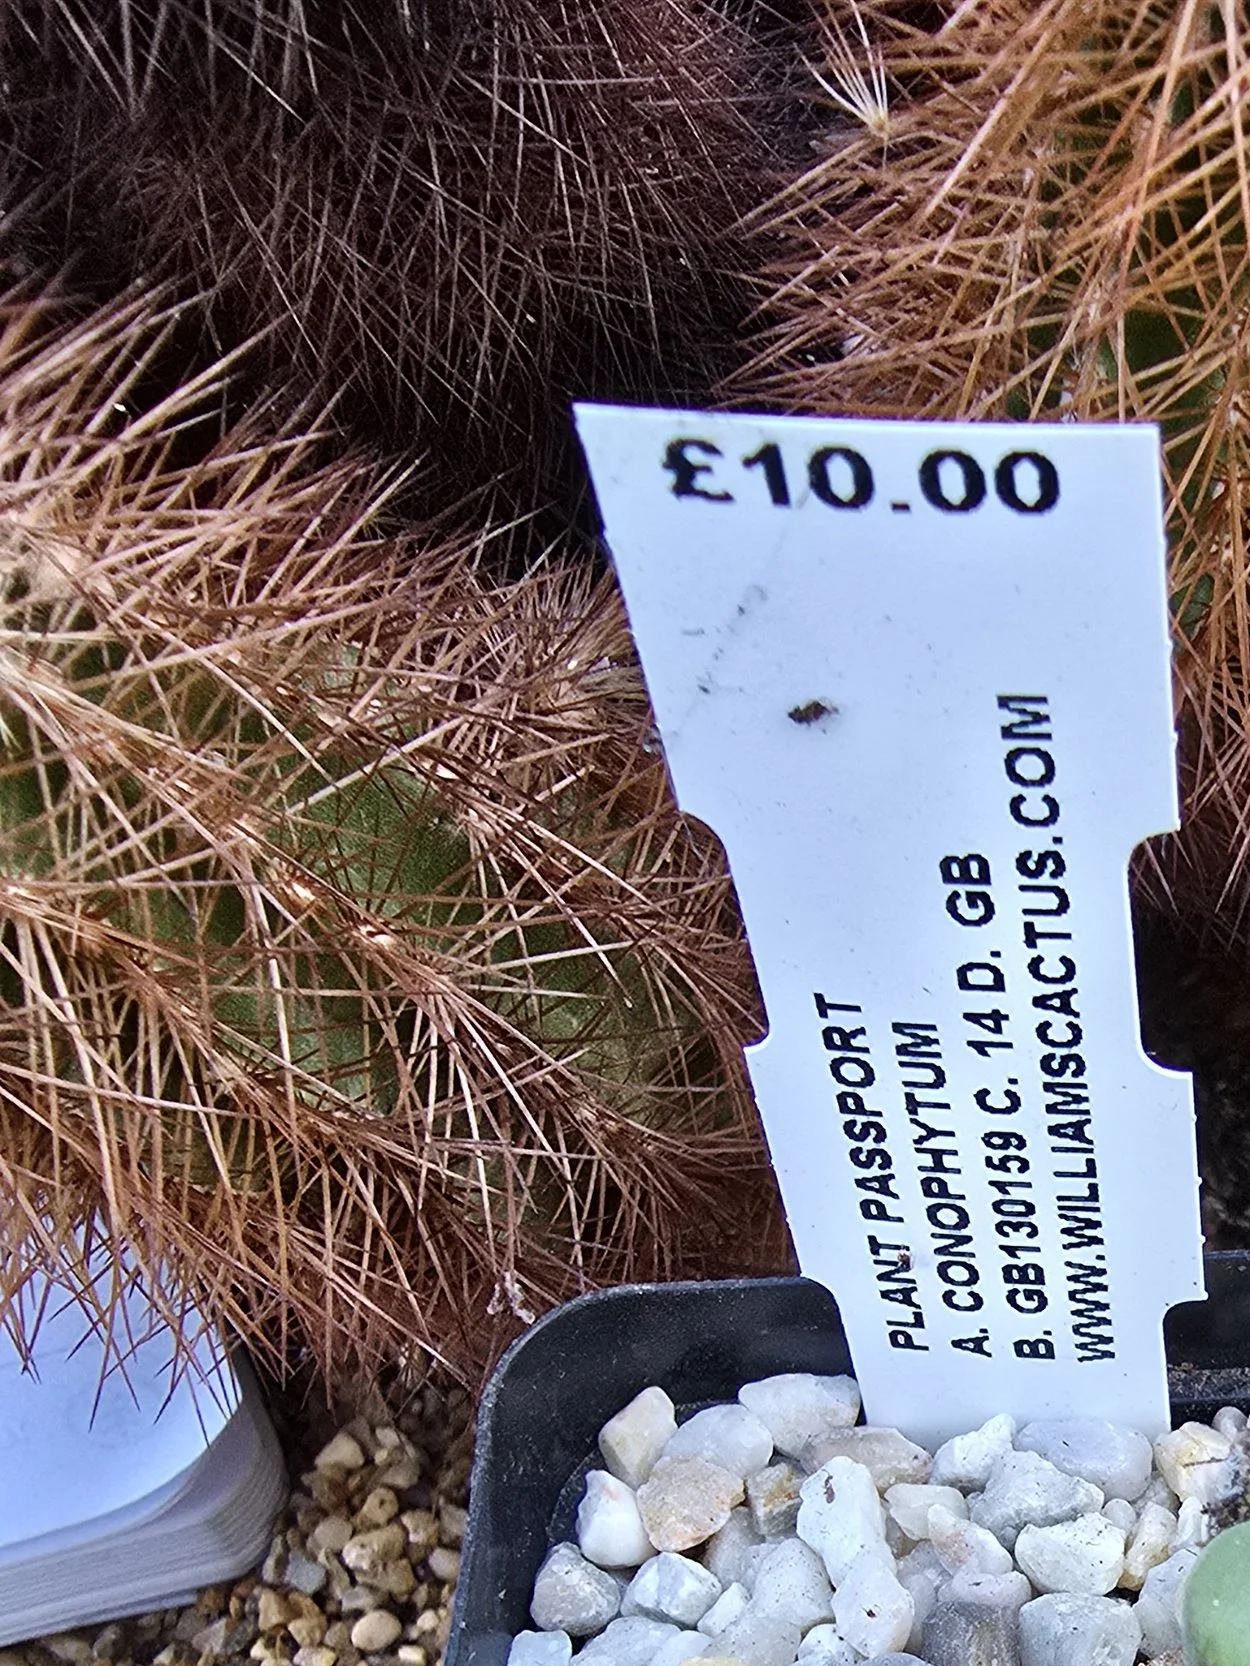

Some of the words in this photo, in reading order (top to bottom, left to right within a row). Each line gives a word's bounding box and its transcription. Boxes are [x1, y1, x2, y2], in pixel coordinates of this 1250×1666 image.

[661, 436, 1061, 515] £10.00
[938, 852, 996, 927] GB
[955, 950, 1006, 993] D.
[961, 1008, 1014, 1058] 14
[995, 694, 1116, 1363] WWW.WILLIAMSCACTUS.COM
[812, 991, 905, 1224] PASSPORT
[972, 1077, 1022, 1115] C.
[890, 1021, 986, 1313] CONOPHYTUM
[979, 1130, 1049, 1314] GB130159
[866, 1234, 930, 1352] PLANT
[950, 1327, 993, 1358] A.
[1012, 1330, 1056, 1360] B.
